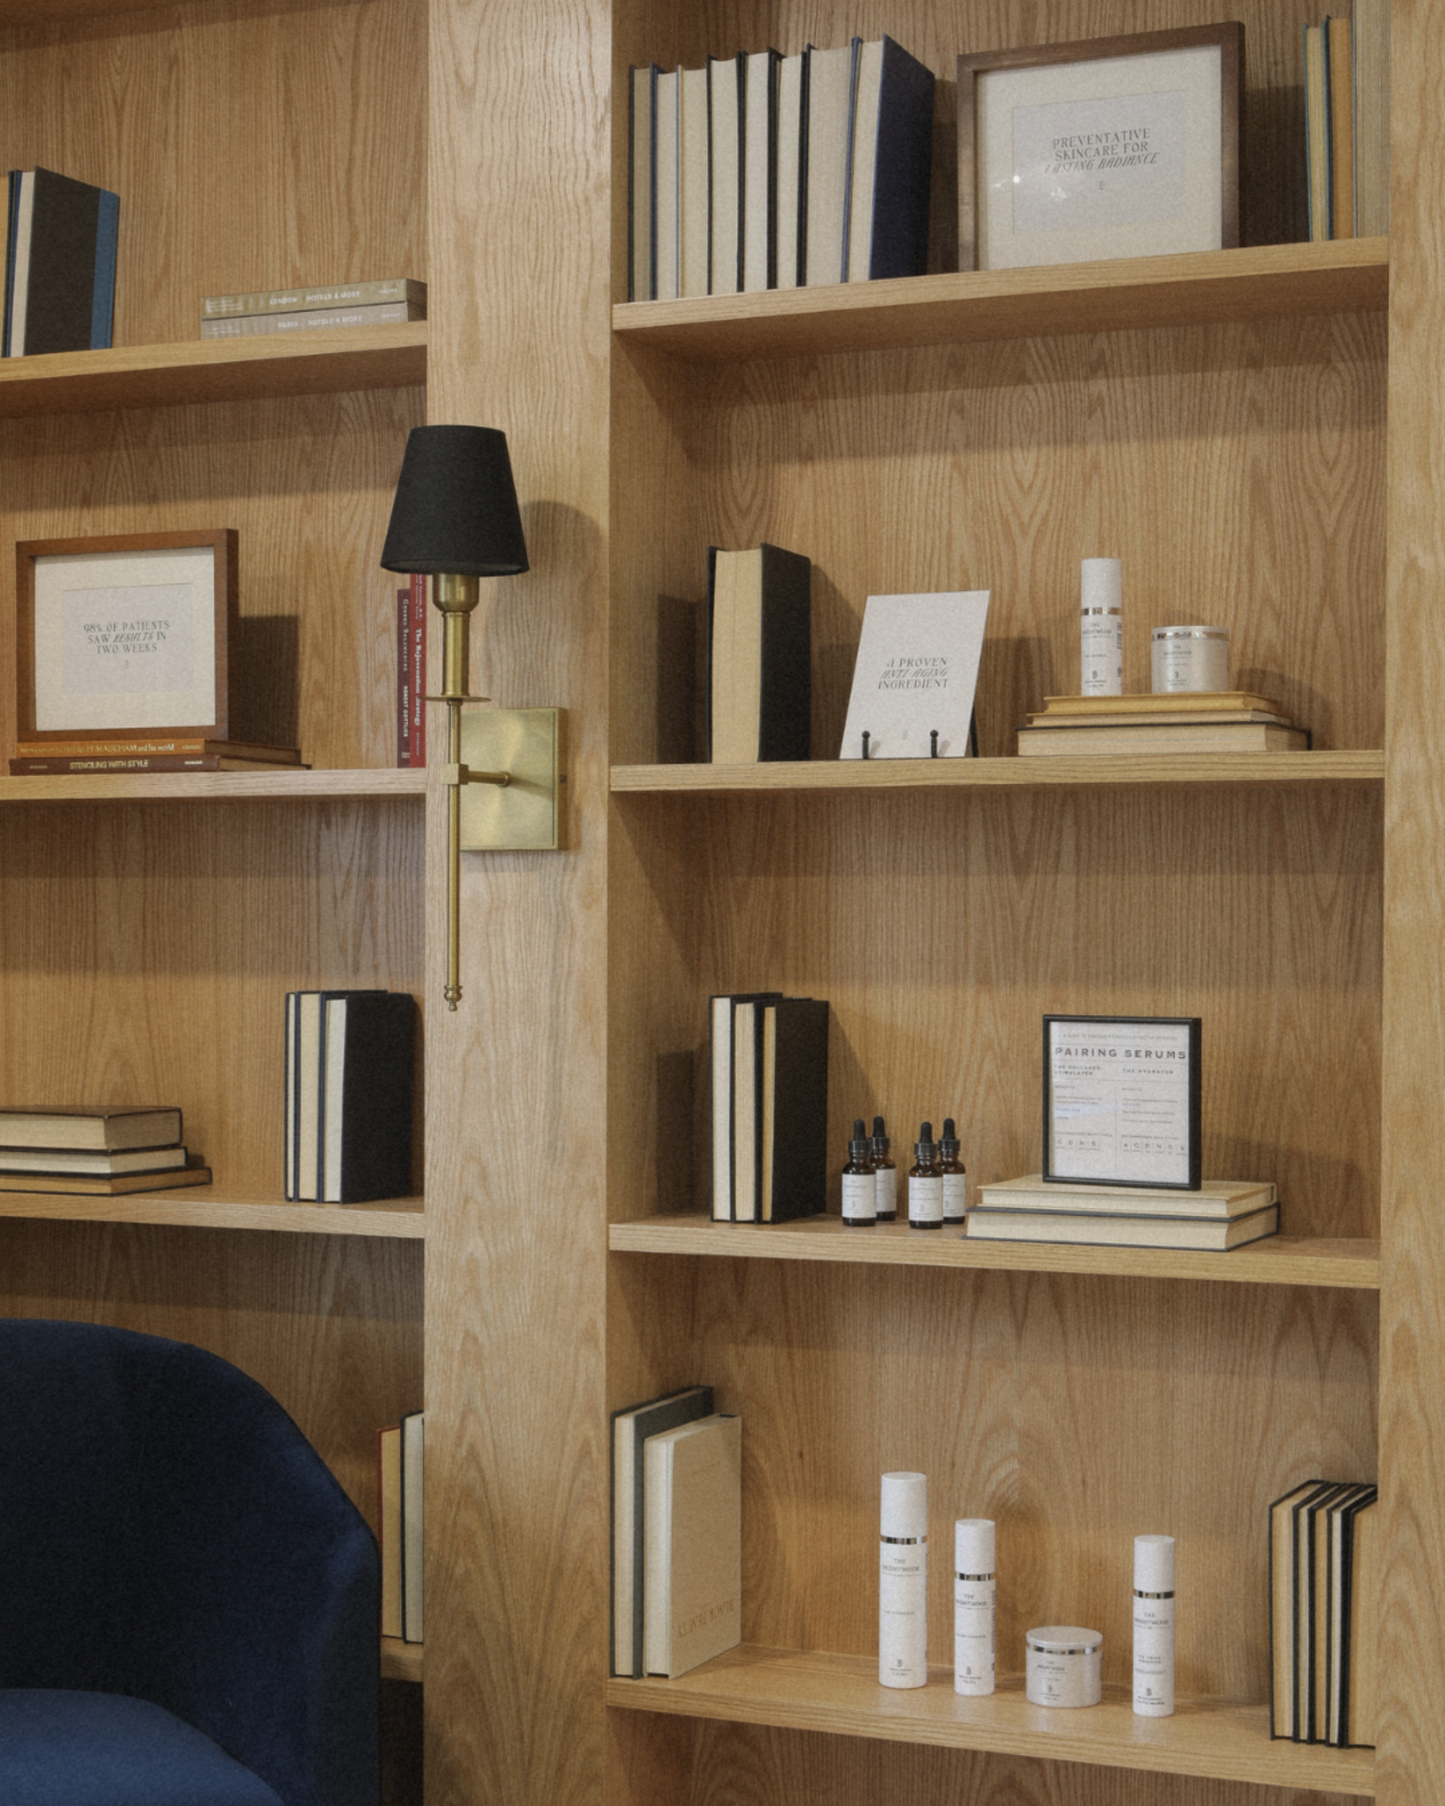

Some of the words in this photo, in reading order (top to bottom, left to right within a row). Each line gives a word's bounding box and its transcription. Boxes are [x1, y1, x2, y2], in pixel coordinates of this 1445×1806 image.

[1052, 128, 1151, 149] PREVENTATIVE
[1054, 144, 1118, 161] SKINCARE
[1123, 141, 1149, 154] FOR
[1098, 152, 1160, 170] RADIANCE
[269, 297, 298, 305] LONDON
[306, 293, 333, 302] HOTELS
[308, 318, 335, 326] HOTELS
[342, 315, 363, 323] MORE
[83, 623, 103, 633] 98%
[106, 622, 119, 632] OF
[122, 620, 170, 631] PATIENTS
[87, 633, 111, 644] SAW
[112, 632, 154, 643] RESULTS
[156, 631, 167, 641] IN
[415, 628, 423, 643] The
[96, 644, 119, 654] TWO
[122, 643, 157, 653] WEEKS
[898, 657, 948, 668] PROVEN
[414, 645, 423, 694] Rejuvenation
[880, 667, 949, 679] ANTI-AGING
[878, 678, 949, 690] INGREDIENT
[158, 743, 175, 752] world
[69, 761, 107, 770] STENCILING
[108, 760, 127, 769] WITH
[127, 759, 149, 768] STYLE
[1055, 1047, 1118, 1057] PAIRING
[1124, 1049, 1187, 1059] SERUMS
